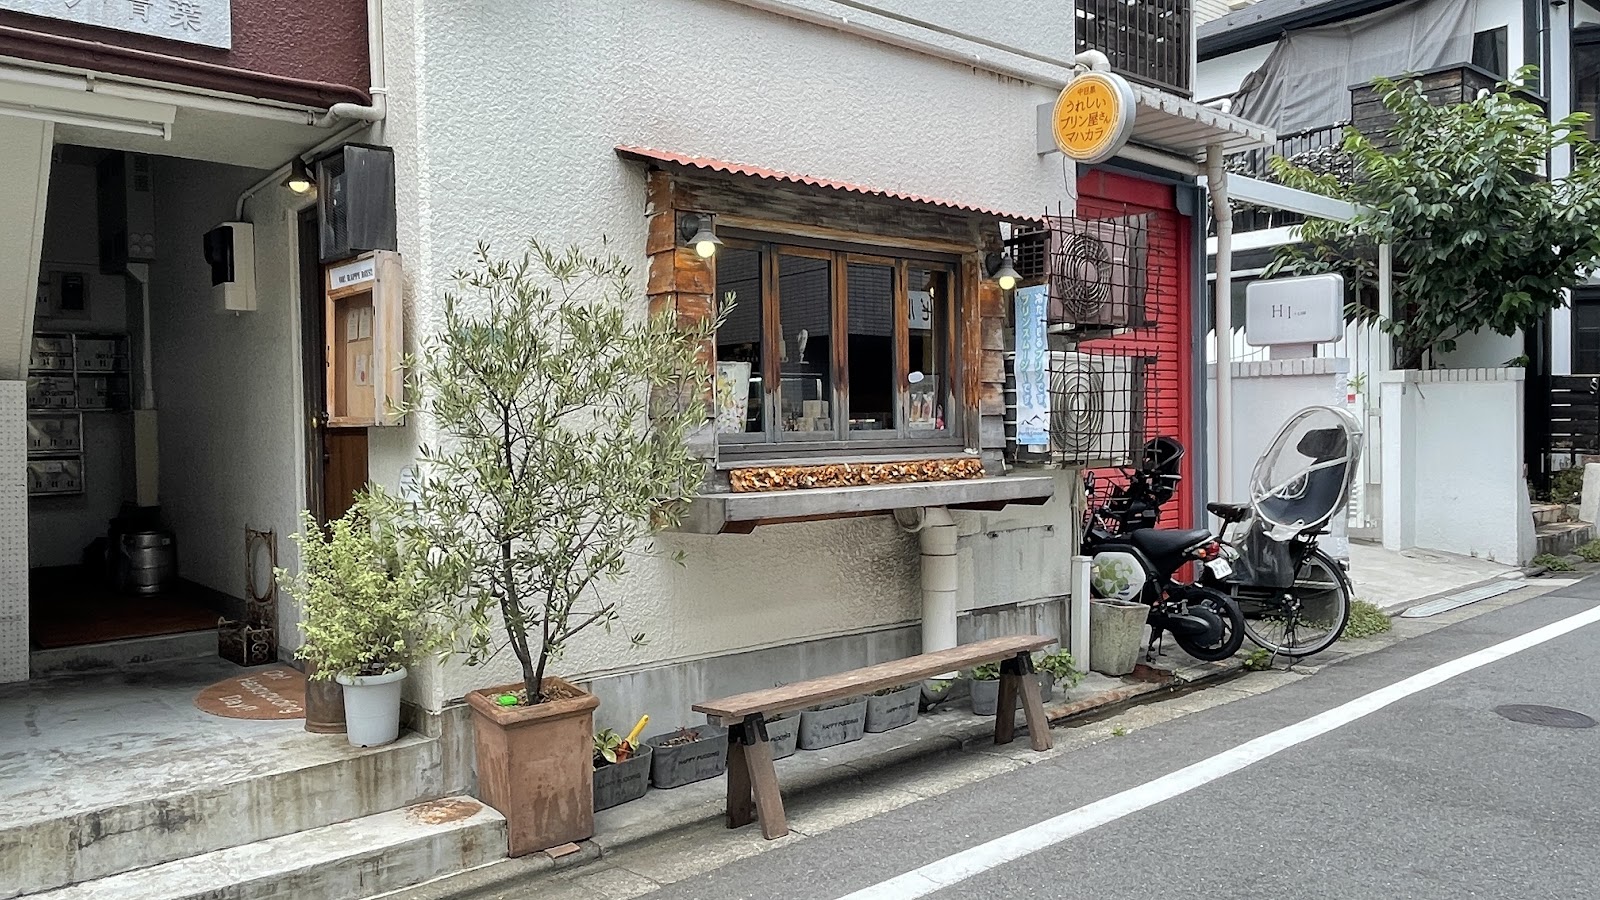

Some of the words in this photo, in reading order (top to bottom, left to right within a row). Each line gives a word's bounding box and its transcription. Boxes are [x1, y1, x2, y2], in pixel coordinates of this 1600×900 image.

[1067, 97, 1106, 113] うれしい
[1066, 127, 1103, 142] マハカラ
